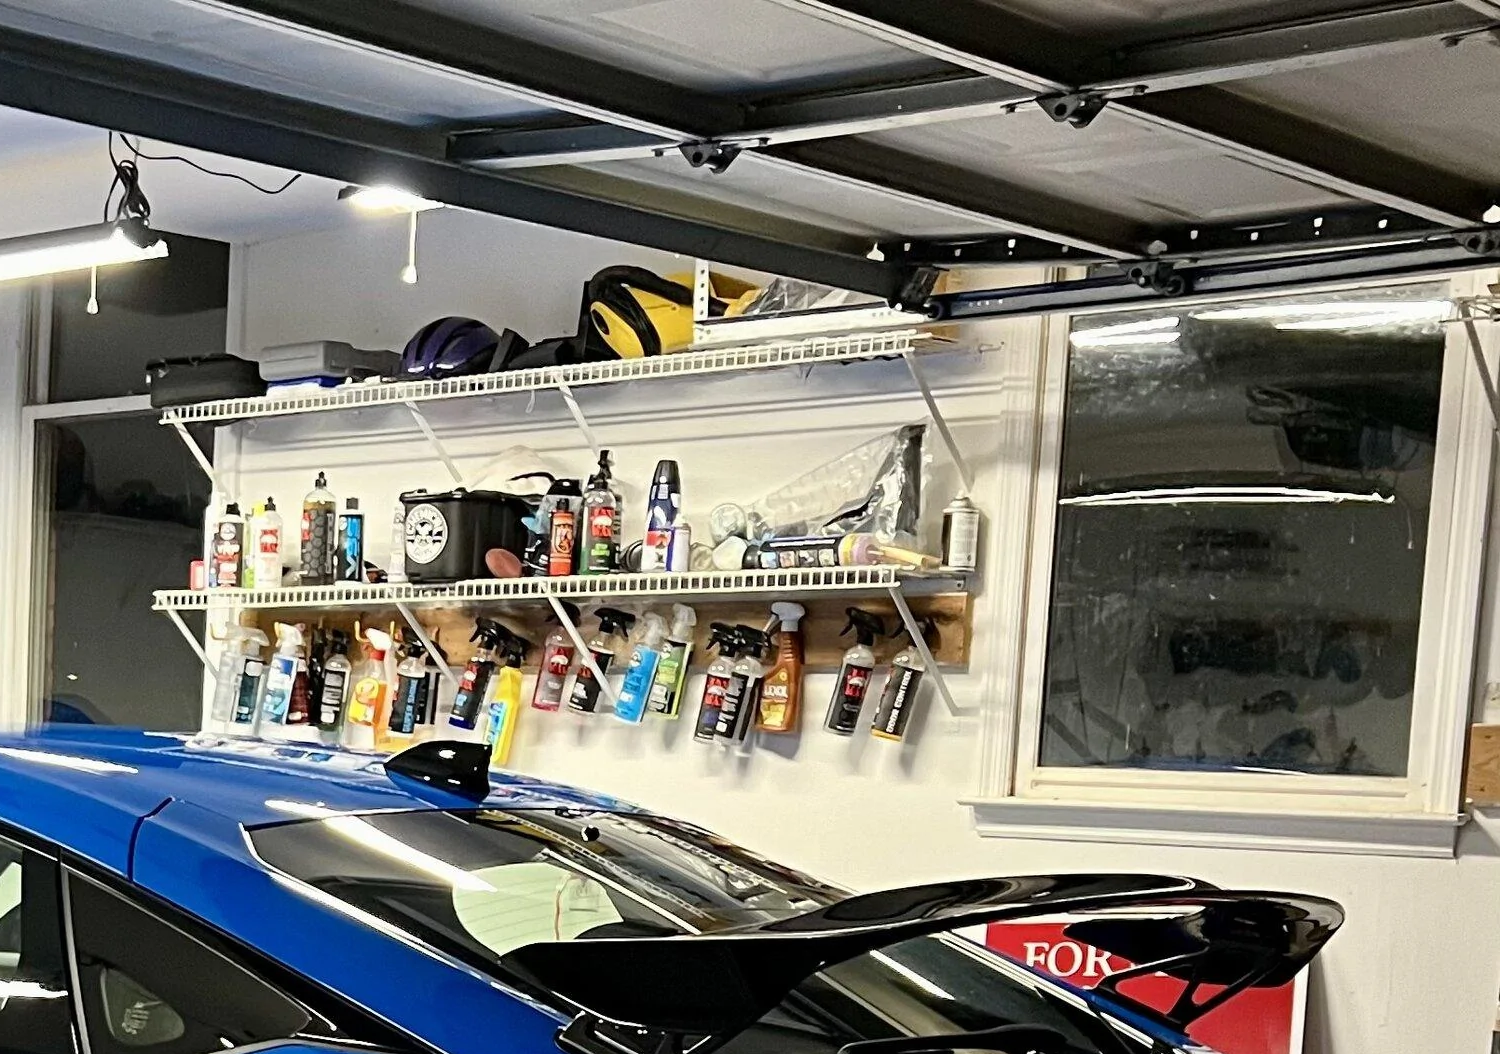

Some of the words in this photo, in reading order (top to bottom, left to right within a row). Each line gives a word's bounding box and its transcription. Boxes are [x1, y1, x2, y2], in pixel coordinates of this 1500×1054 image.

[886, 708, 900, 734] ODOR
[894, 669, 913, 709] CONTROL
[1023, 941, 1116, 977] FOR
